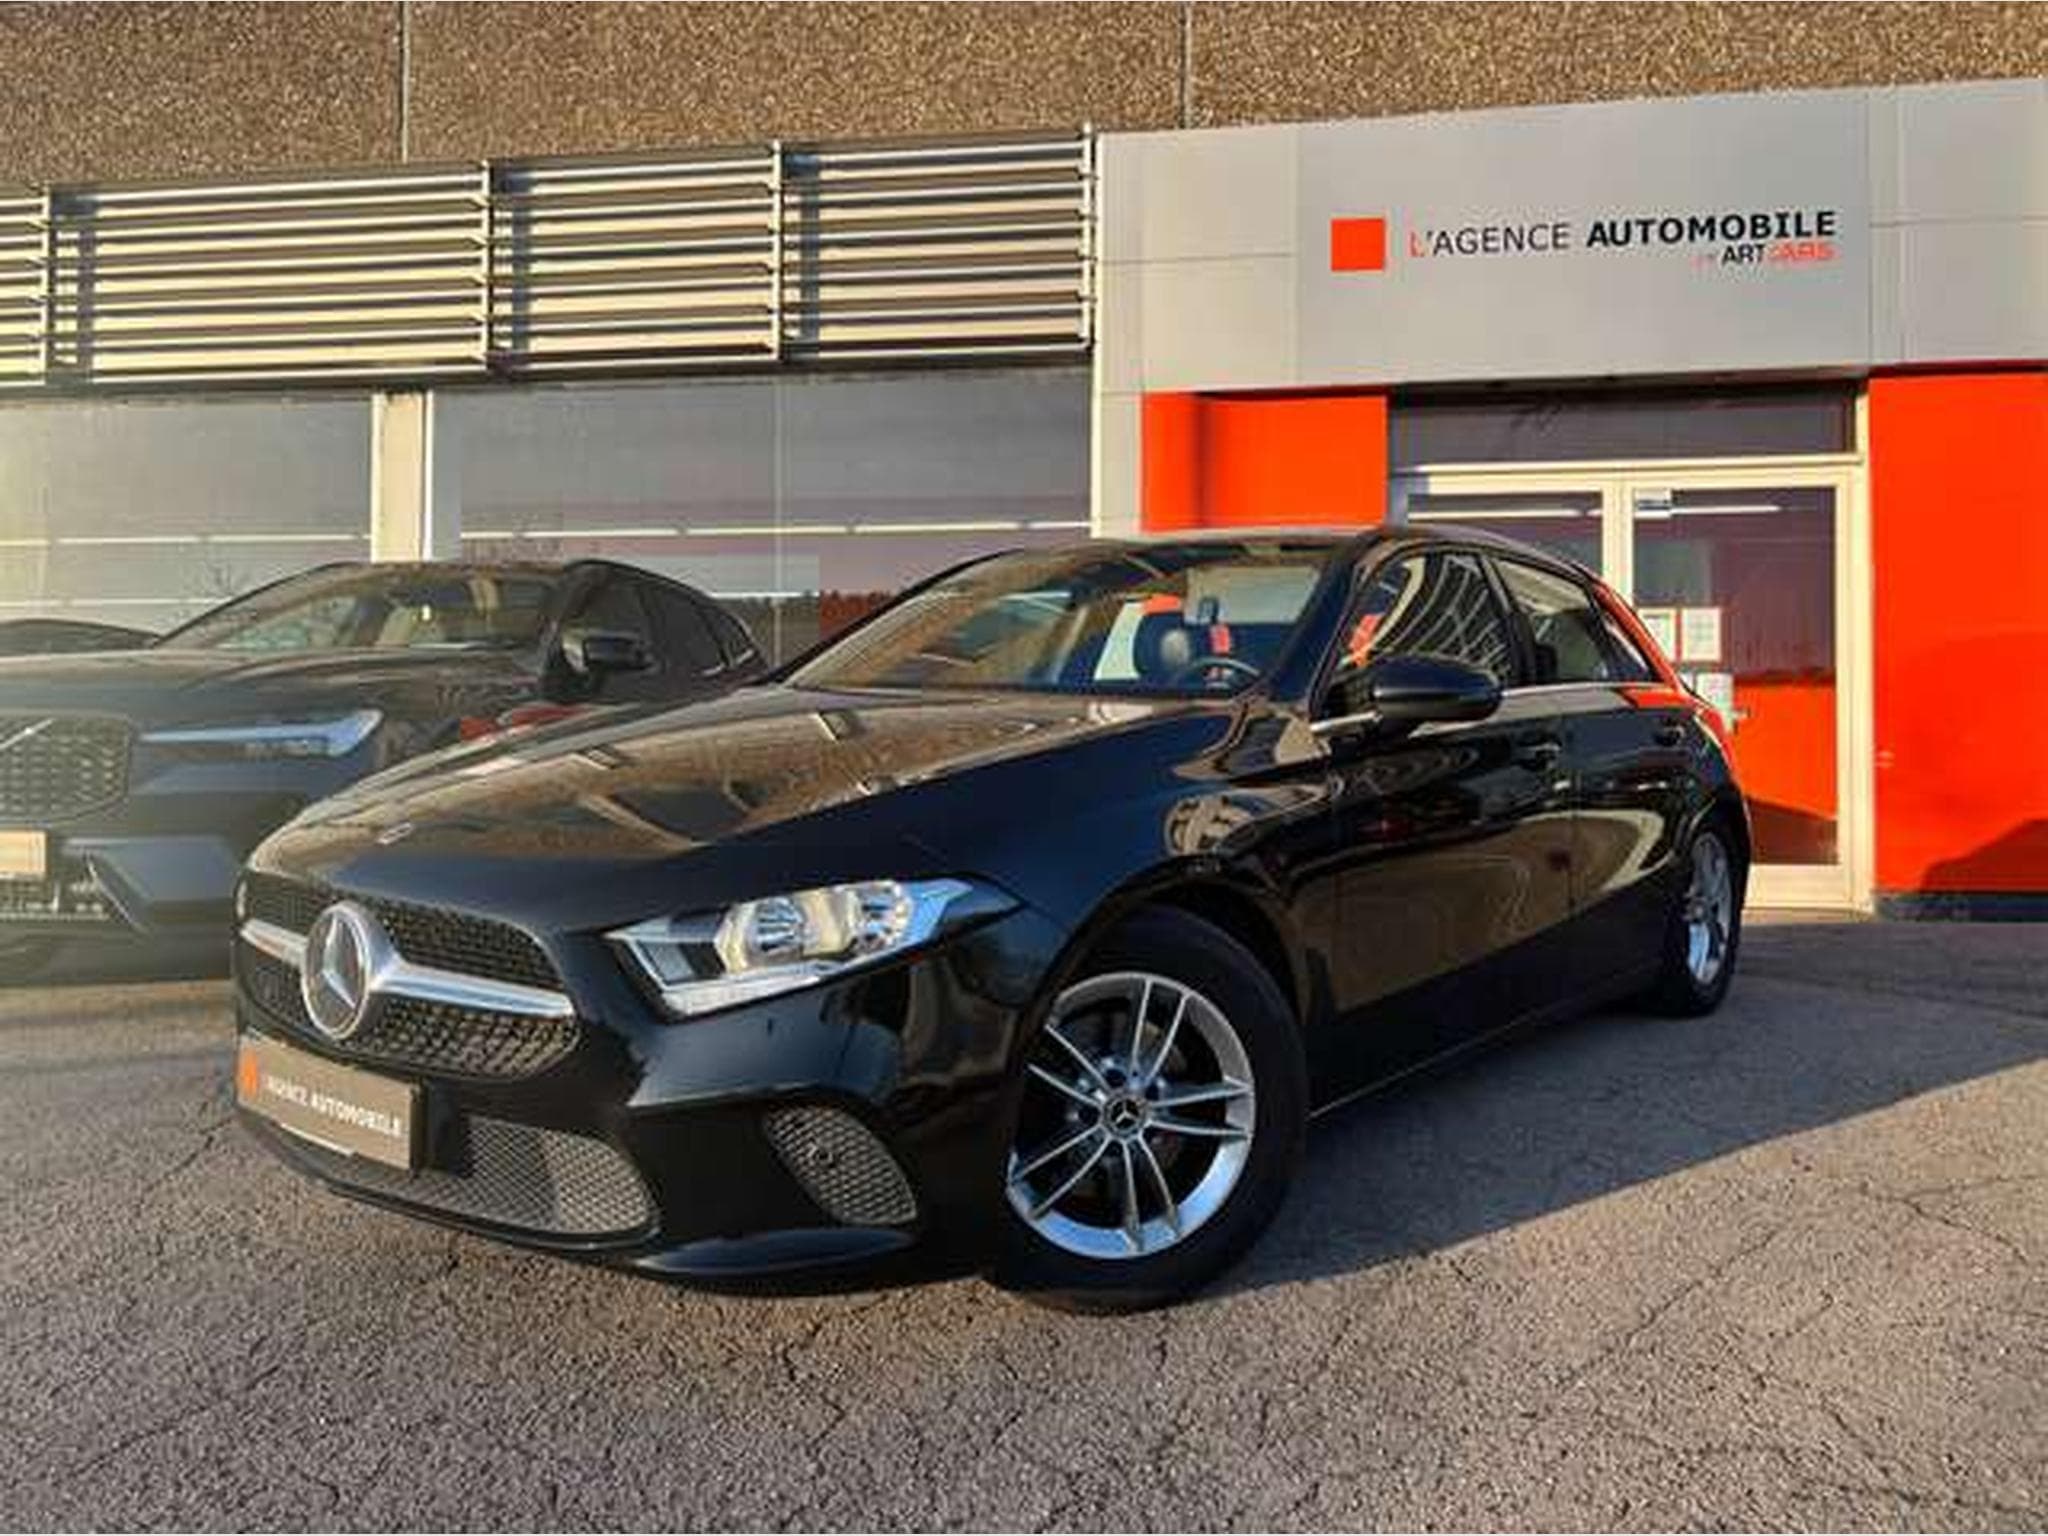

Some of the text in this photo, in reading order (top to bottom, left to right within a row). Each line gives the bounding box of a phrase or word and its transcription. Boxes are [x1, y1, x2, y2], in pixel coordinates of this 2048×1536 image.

[1408, 211, 1836, 257] L'AGENCE AUTOMOBILE
[311, 1092, 401, 1137] AUTOMOBILE
